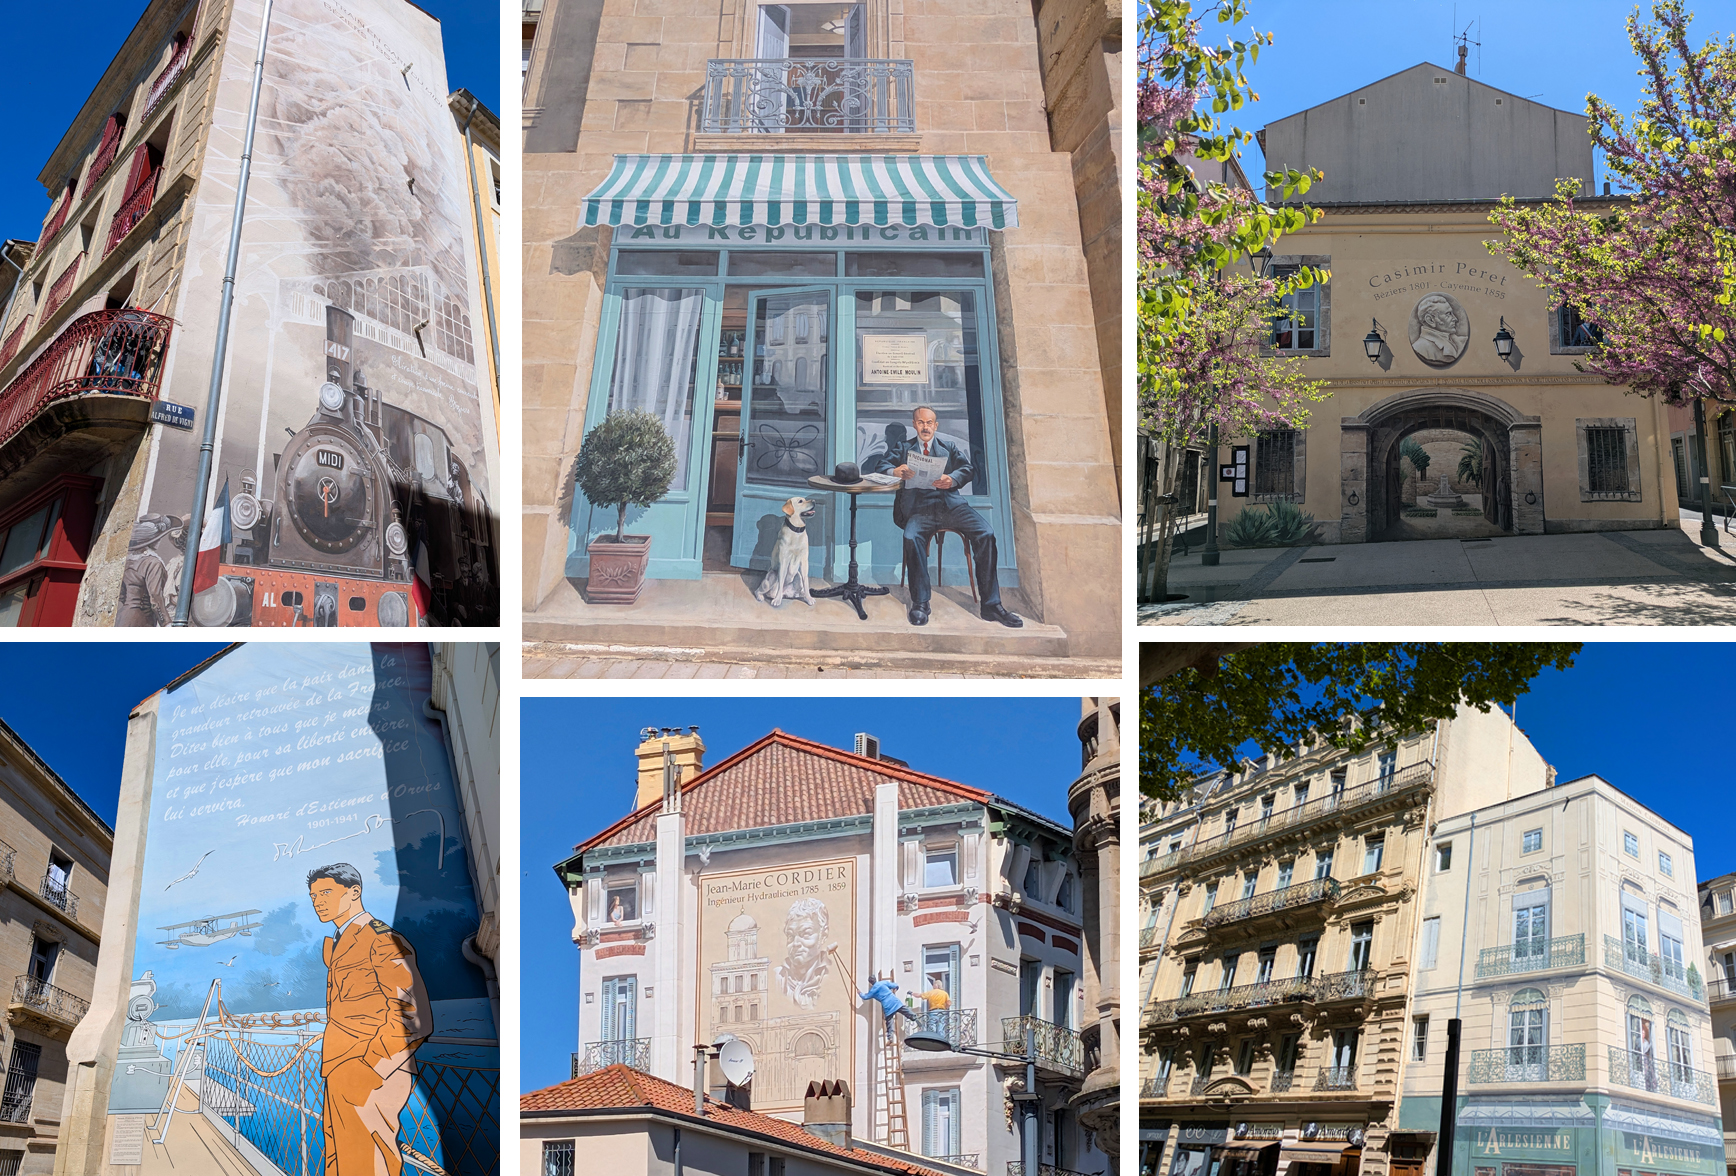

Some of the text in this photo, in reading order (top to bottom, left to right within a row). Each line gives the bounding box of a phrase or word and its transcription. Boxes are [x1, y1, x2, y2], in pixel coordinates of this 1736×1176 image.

[630, 224, 681, 239] Au
[1369, 262, 1507, 288] Casimir Peret
[1409, 281, 1430, 291] 1801
[1440, 281, 1482, 293] Cayenne
[1484, 287, 1506, 300] 1855
[151, 411, 171, 422] ALFRED
[172, 416, 178, 424] DE
[166, 404, 183, 415] RUE
[319, 451, 342, 468] MIDI
[261, 592, 277, 607] AL
[171, 654, 397, 723] Je ne désire que la paix dans la
[171, 717, 230, 741] grandeur
[236, 696, 300, 722] retrouvée
[305, 691, 323, 706] de
[327, 688, 343, 702] la
[170, 700, 391, 759] Dites bien à tous que je meurs
[166, 764, 199, 782] pour
[234, 749, 270, 767] pour
[275, 743, 292, 754] sa
[297, 725, 346, 751] liberté
[166, 786, 180, 799] et
[183, 782, 207, 800] que
[268, 764, 293, 782] que
[297, 756, 331, 772] mon
[336, 738, 410, 763] sacrifice
[164, 805, 186, 822] lui
[235, 806, 291, 827] Honoré
[306, 813, 359, 830] 1901-1941
[706, 865, 847, 897] Jean-Marie CORDIER
[707, 894, 746, 908] Ingénieur
[747, 889, 799, 904] Hydraulicien
[800, 884, 819, 895] 1785
[828, 882, 847, 892] 1859
